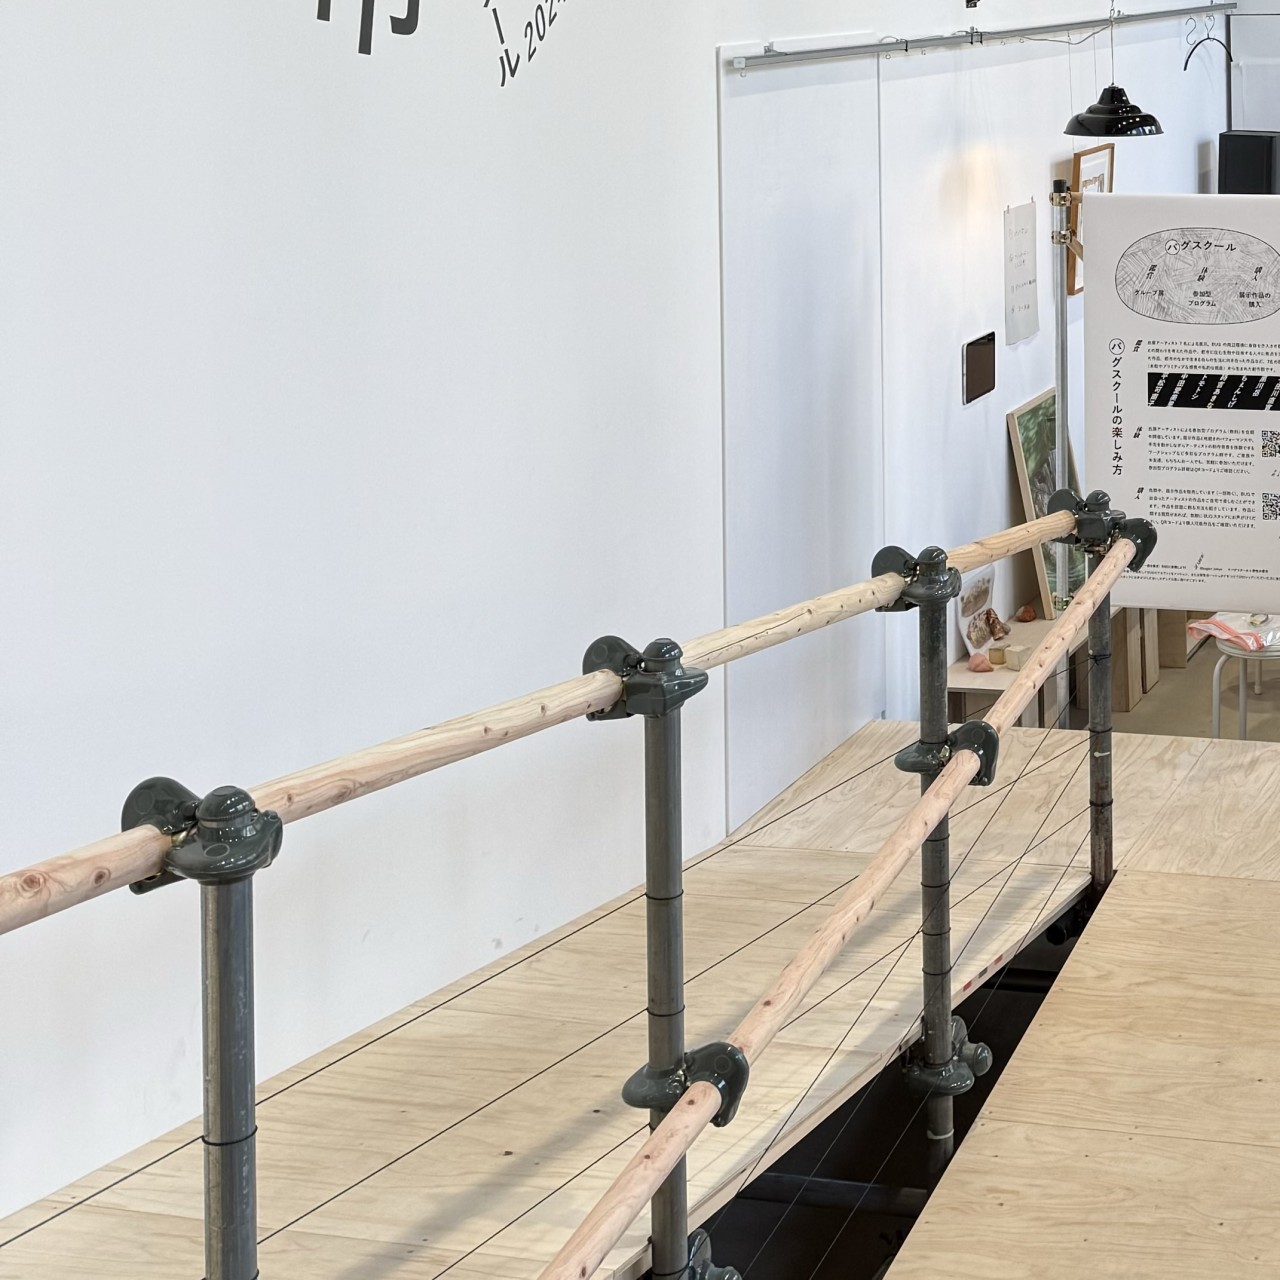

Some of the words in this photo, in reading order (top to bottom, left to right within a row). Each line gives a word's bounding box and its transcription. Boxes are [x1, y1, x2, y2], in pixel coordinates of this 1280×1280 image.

[1165, 239, 1237, 256] バグスクール
[1109, 338, 1125, 476] バグスクールの楽しみ方
